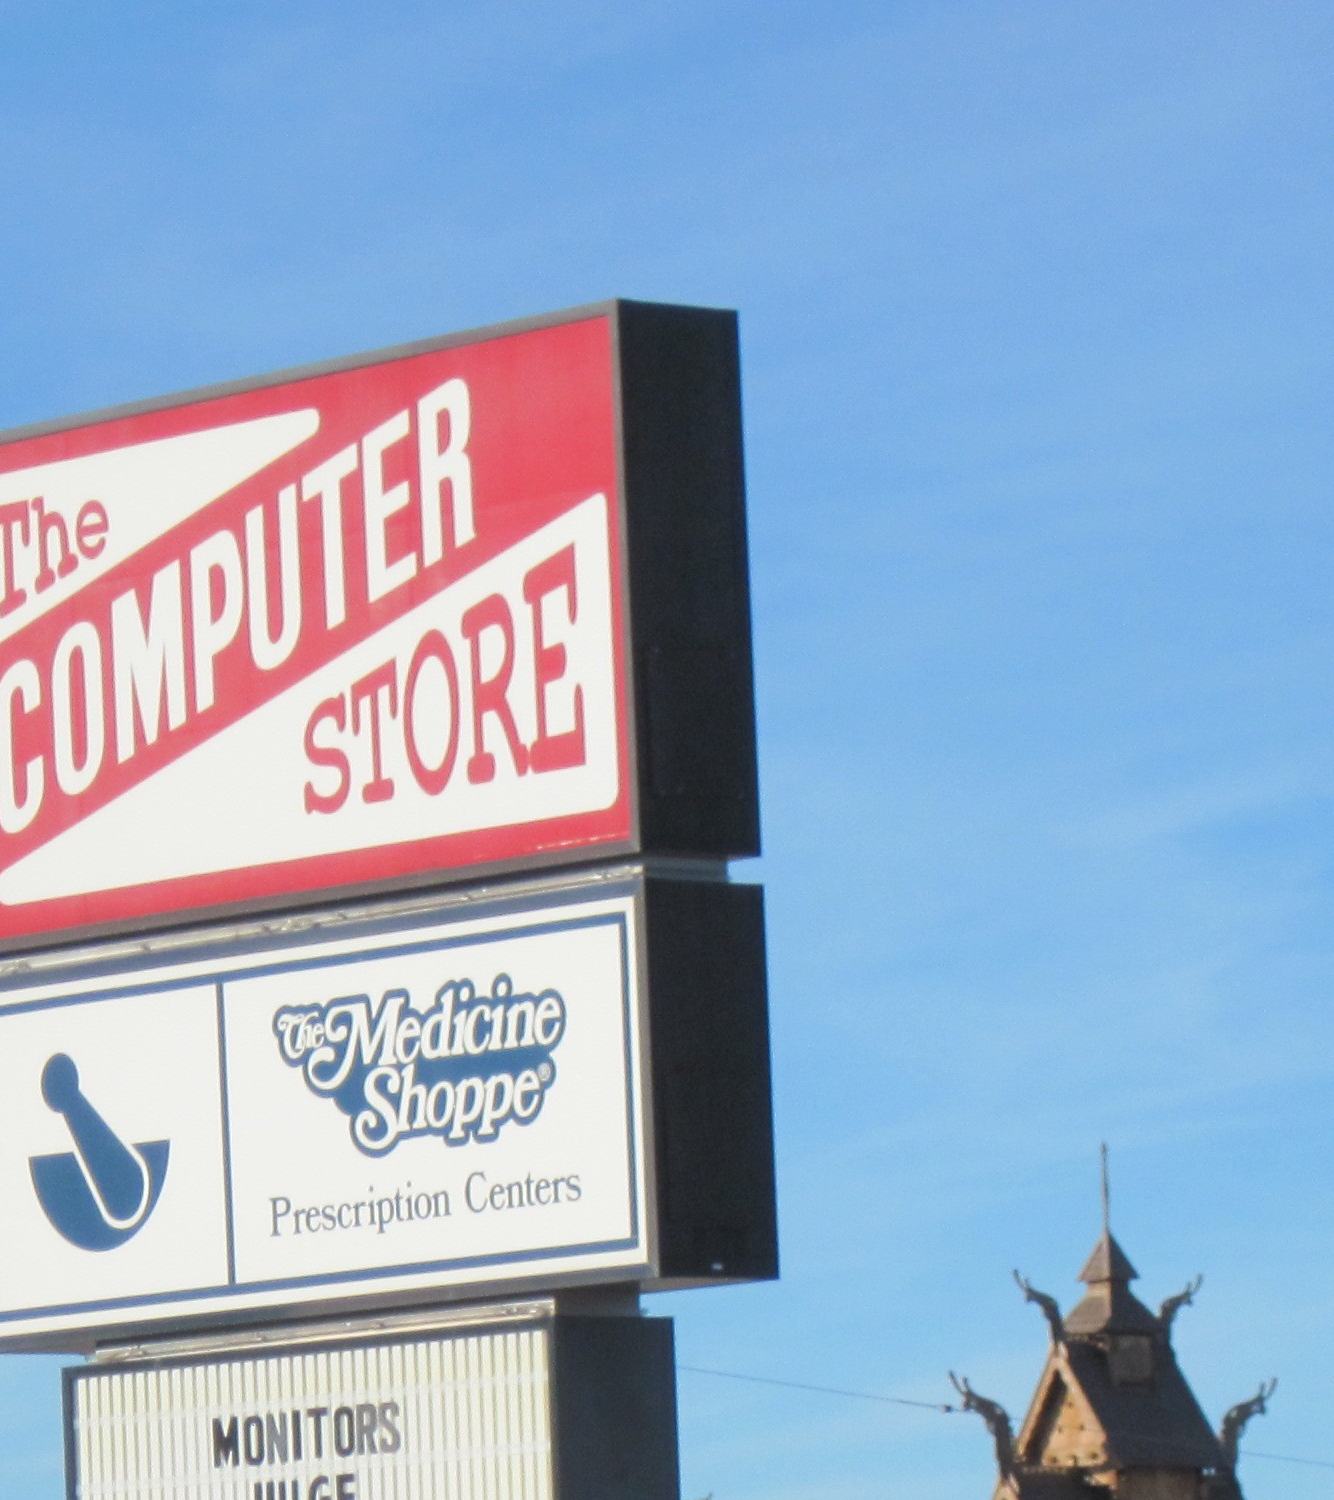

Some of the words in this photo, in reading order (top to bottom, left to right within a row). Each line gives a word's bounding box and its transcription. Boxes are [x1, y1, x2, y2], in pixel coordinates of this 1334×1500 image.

[304, 541, 588, 816] STORE
[278, 1012, 327, 1059] The
[307, 979, 562, 1090] Medicine
[269, 1181, 452, 1237] Prescription
[465, 1171, 582, 1213] Centers
[212, 1401, 401, 1467] MONITORS
